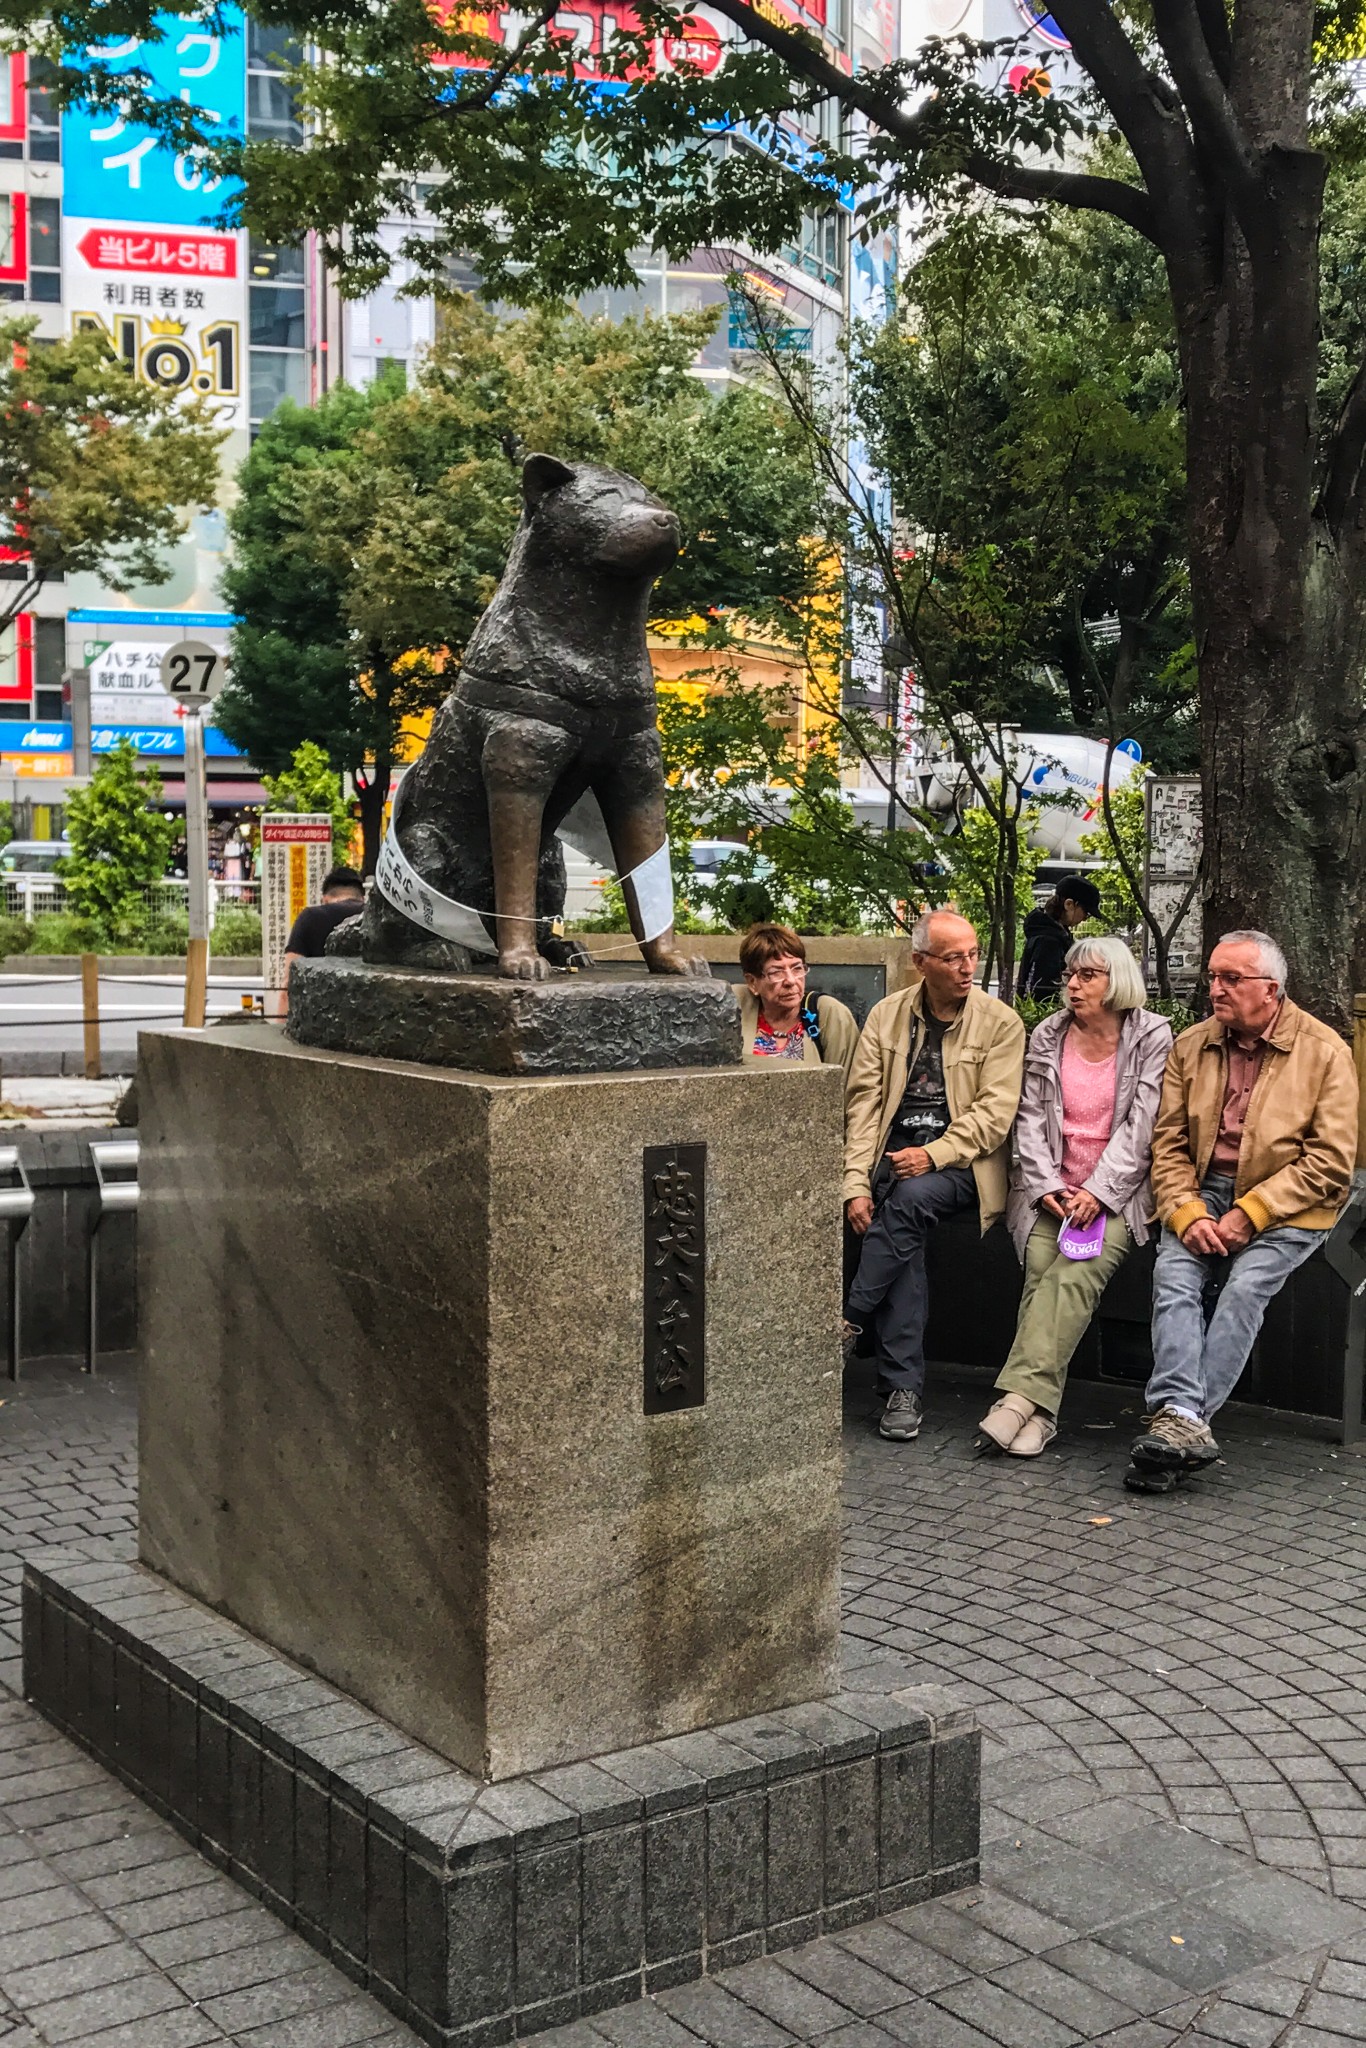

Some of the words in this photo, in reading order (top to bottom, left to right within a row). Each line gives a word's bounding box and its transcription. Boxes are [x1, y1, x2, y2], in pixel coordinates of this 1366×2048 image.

[671, 41, 716, 61] ガスト
[98, 236, 225, 271] 当ビル5階
[103, 283, 206, 309] 利用者数
[72, 311, 239, 397] No.1
[105, 652, 162, 669] ハチ公
[169, 655, 216, 692] 27
[1063, 1241, 1099, 1255] TOKYO
[650, 1160, 700, 1393] 忠犬ハチ公
